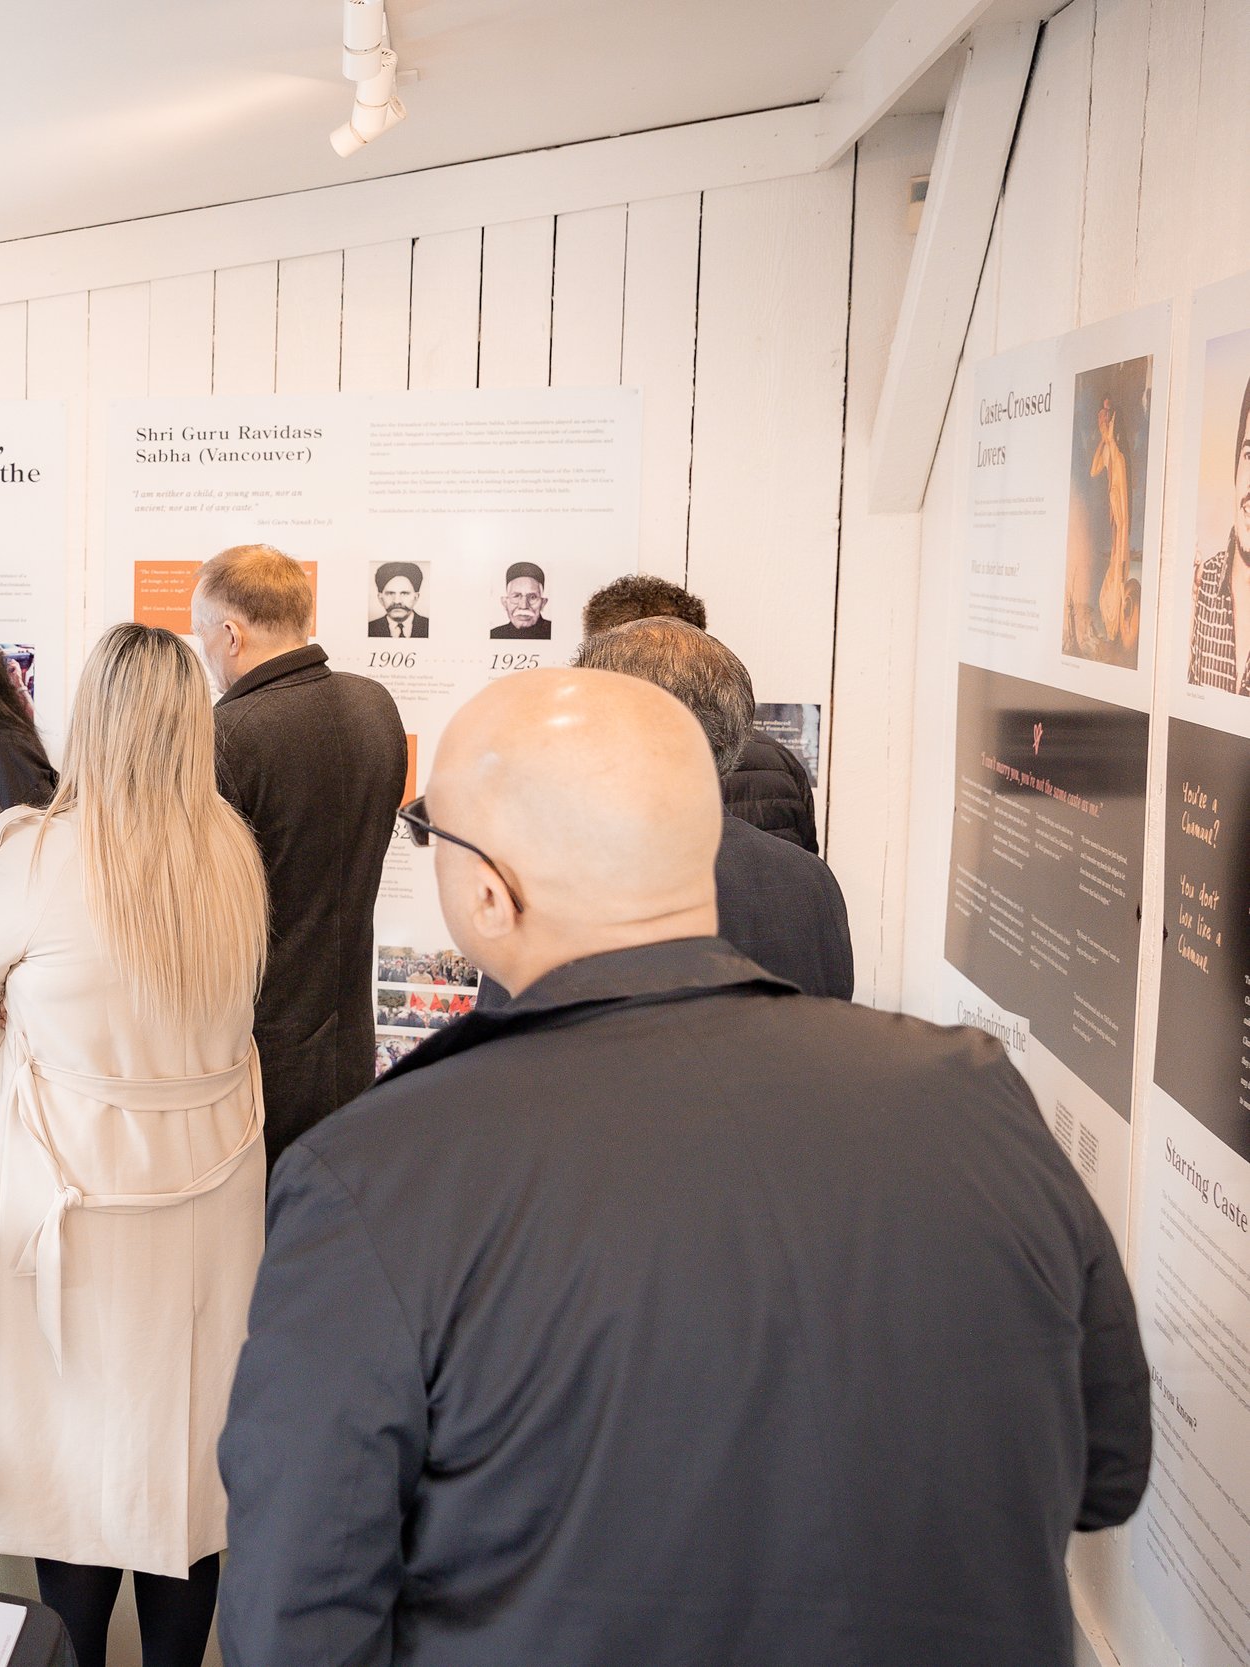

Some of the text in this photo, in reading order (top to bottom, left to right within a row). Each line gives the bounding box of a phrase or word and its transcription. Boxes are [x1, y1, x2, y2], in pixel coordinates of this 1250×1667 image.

[980, 382, 1052, 426] Caste-Crossed
[136, 425, 323, 442] Shri Guru Ravidass
[136, 447, 312, 465] Sabha (Vancouver)
[977, 441, 1006, 468] Lovers
[0, 463, 41, 483] the
[156, 489, 184, 498] neither
[225, 490, 250, 499] young
[367, 651, 540, 671] 1906 1925
[1180, 874, 1195, 899] You
[1012, 1021, 1027, 1053] the
[1165, 1136, 1210, 1205] Starring
[1213, 1181, 1249, 1233] Caste
[1176, 1396, 1198, 1433] know?
